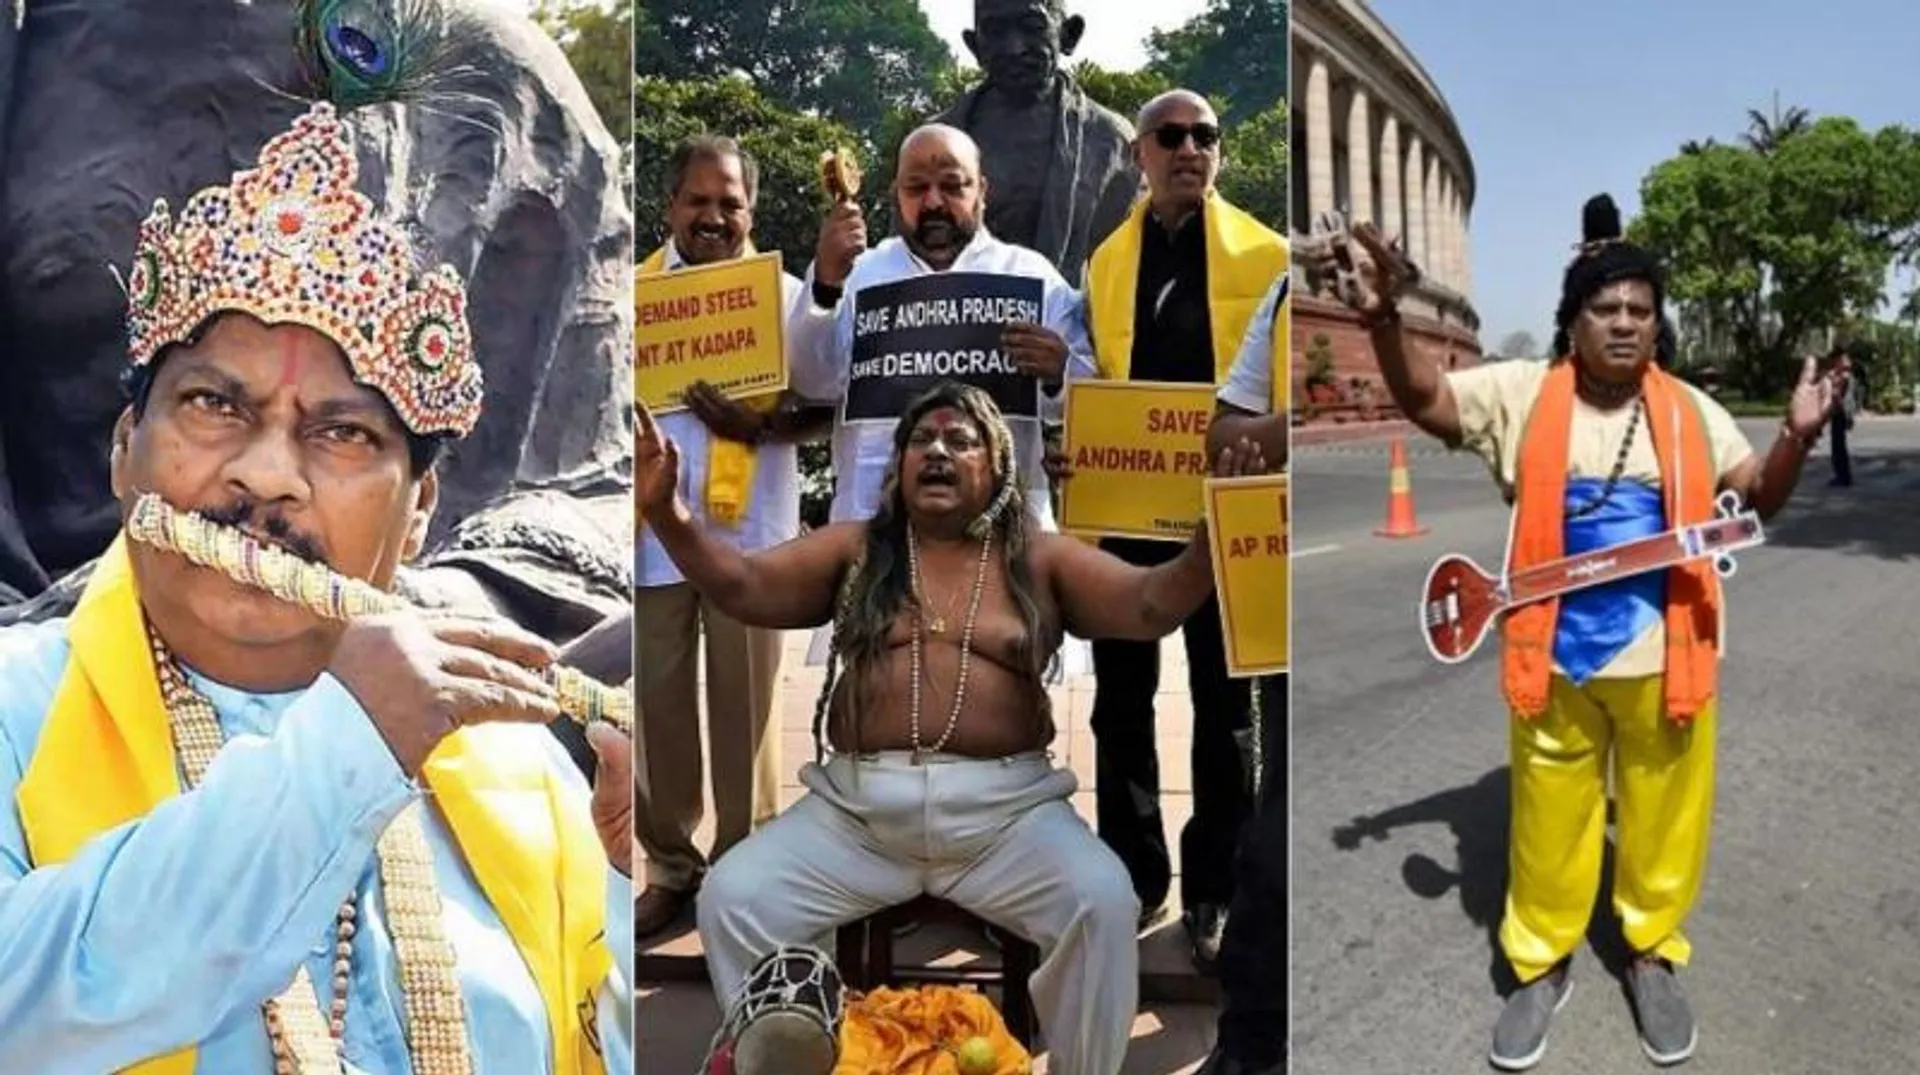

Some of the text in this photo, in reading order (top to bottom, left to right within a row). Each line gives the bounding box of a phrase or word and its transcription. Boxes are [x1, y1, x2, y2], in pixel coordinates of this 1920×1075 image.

[706, 287, 758, 315] STEEL
[857, 297, 1039, 337] SAVE ANDHRA PRADESH
[665, 340, 687, 366] AT
[691, 326, 757, 362] KADAPA
[852, 348, 1019, 381] SAVE DEMOCRAC
[1147, 407, 1207, 435] SAVE
[1076, 446, 1207, 477] ANDHRA PR
[1228, 536, 1261, 559] AP
